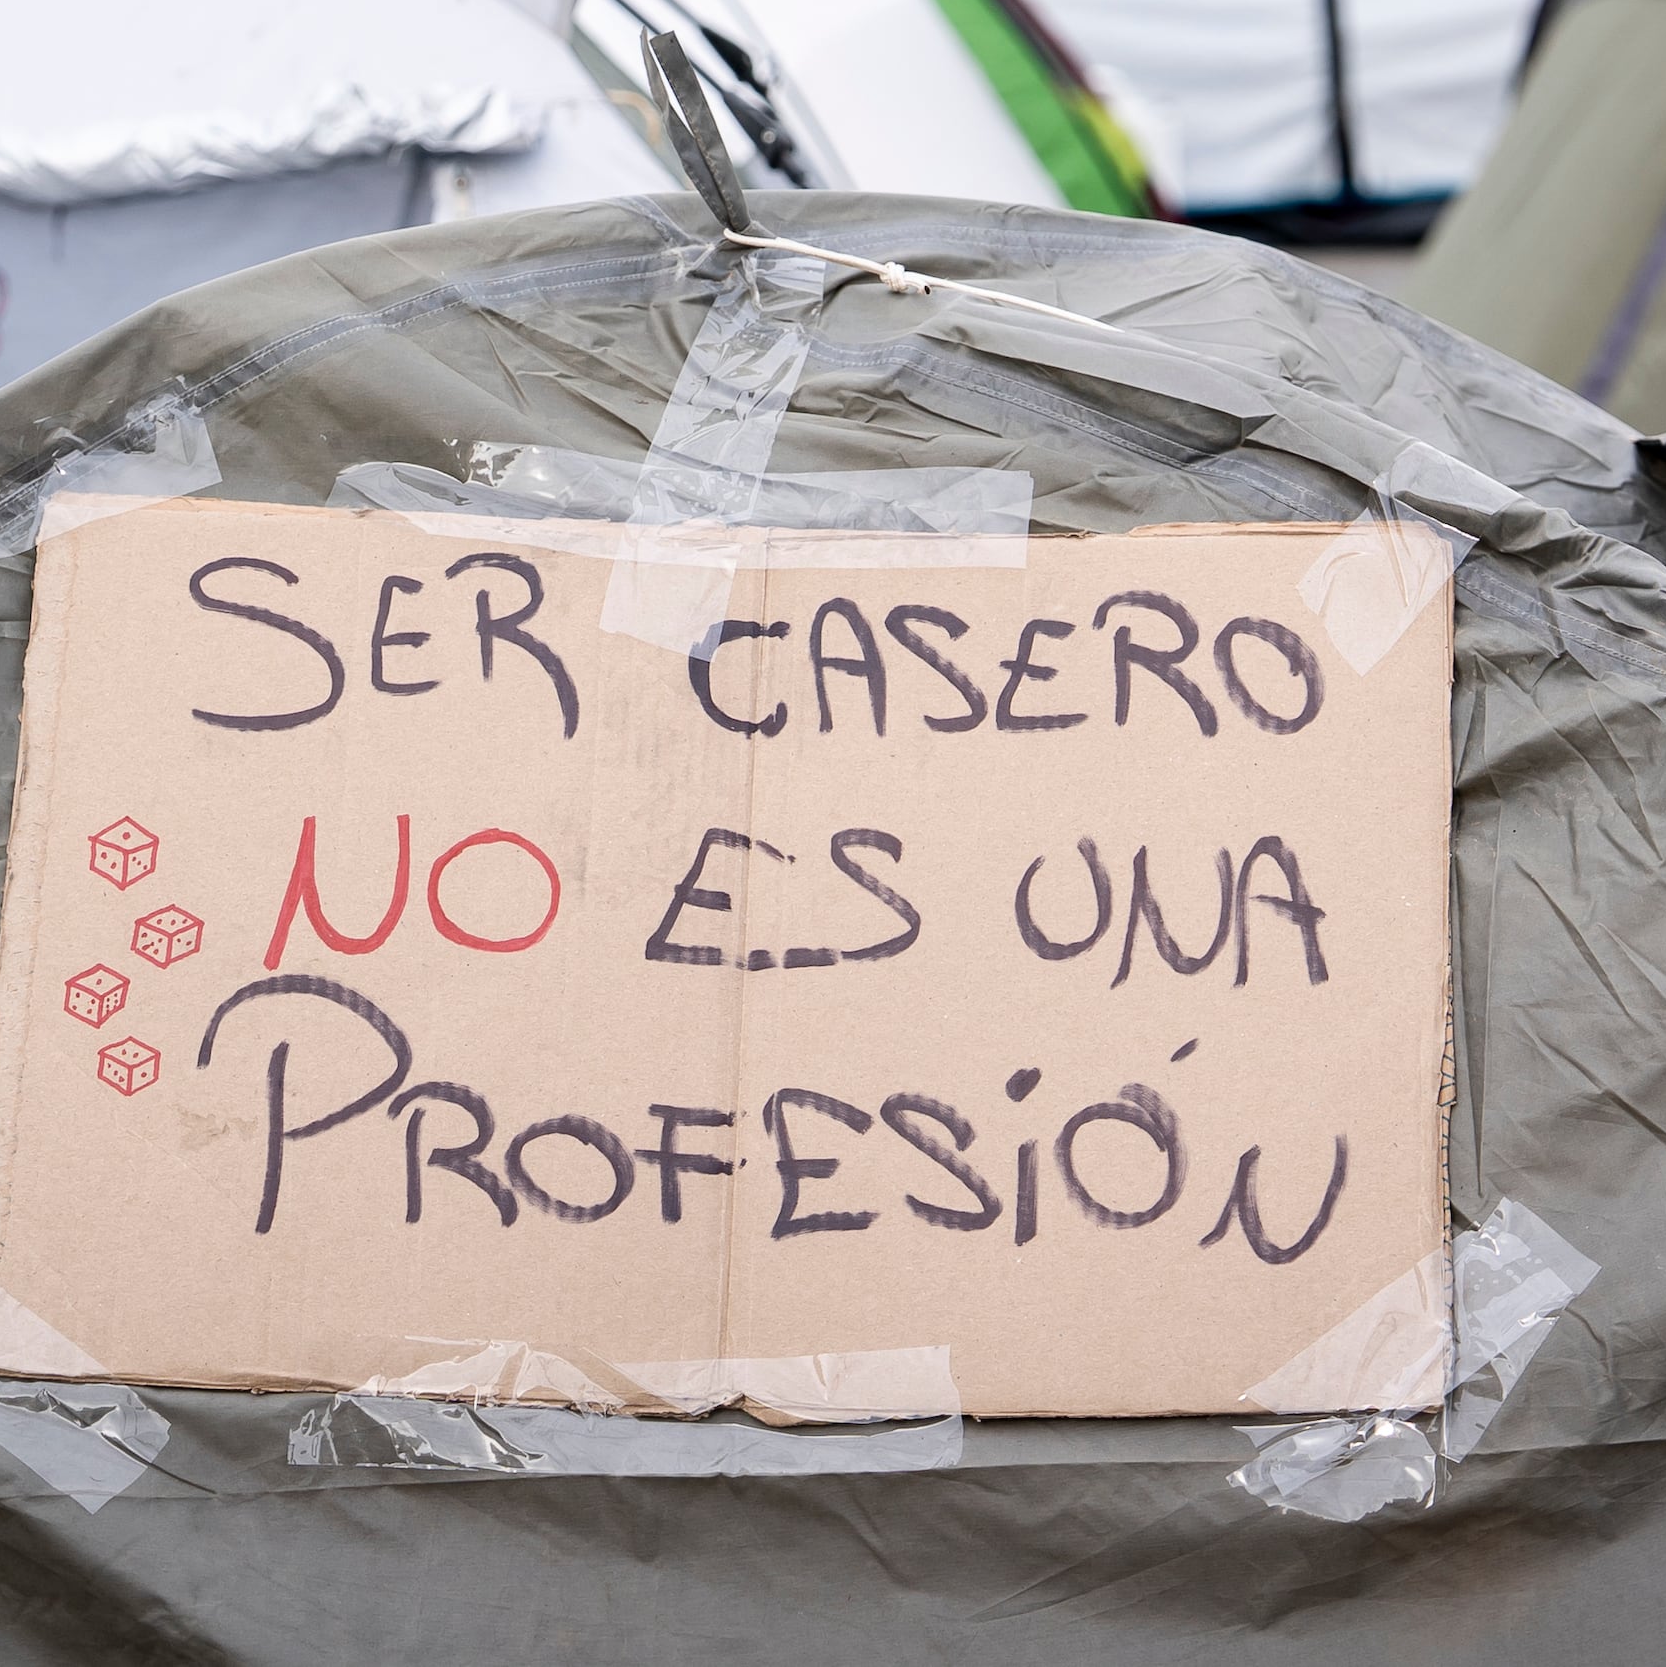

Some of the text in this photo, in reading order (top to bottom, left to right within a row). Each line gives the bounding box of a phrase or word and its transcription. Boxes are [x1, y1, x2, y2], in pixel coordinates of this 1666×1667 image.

[188, 551, 1325, 739] SER CASERO
[263, 814, 1330, 987] NO ES UNA
